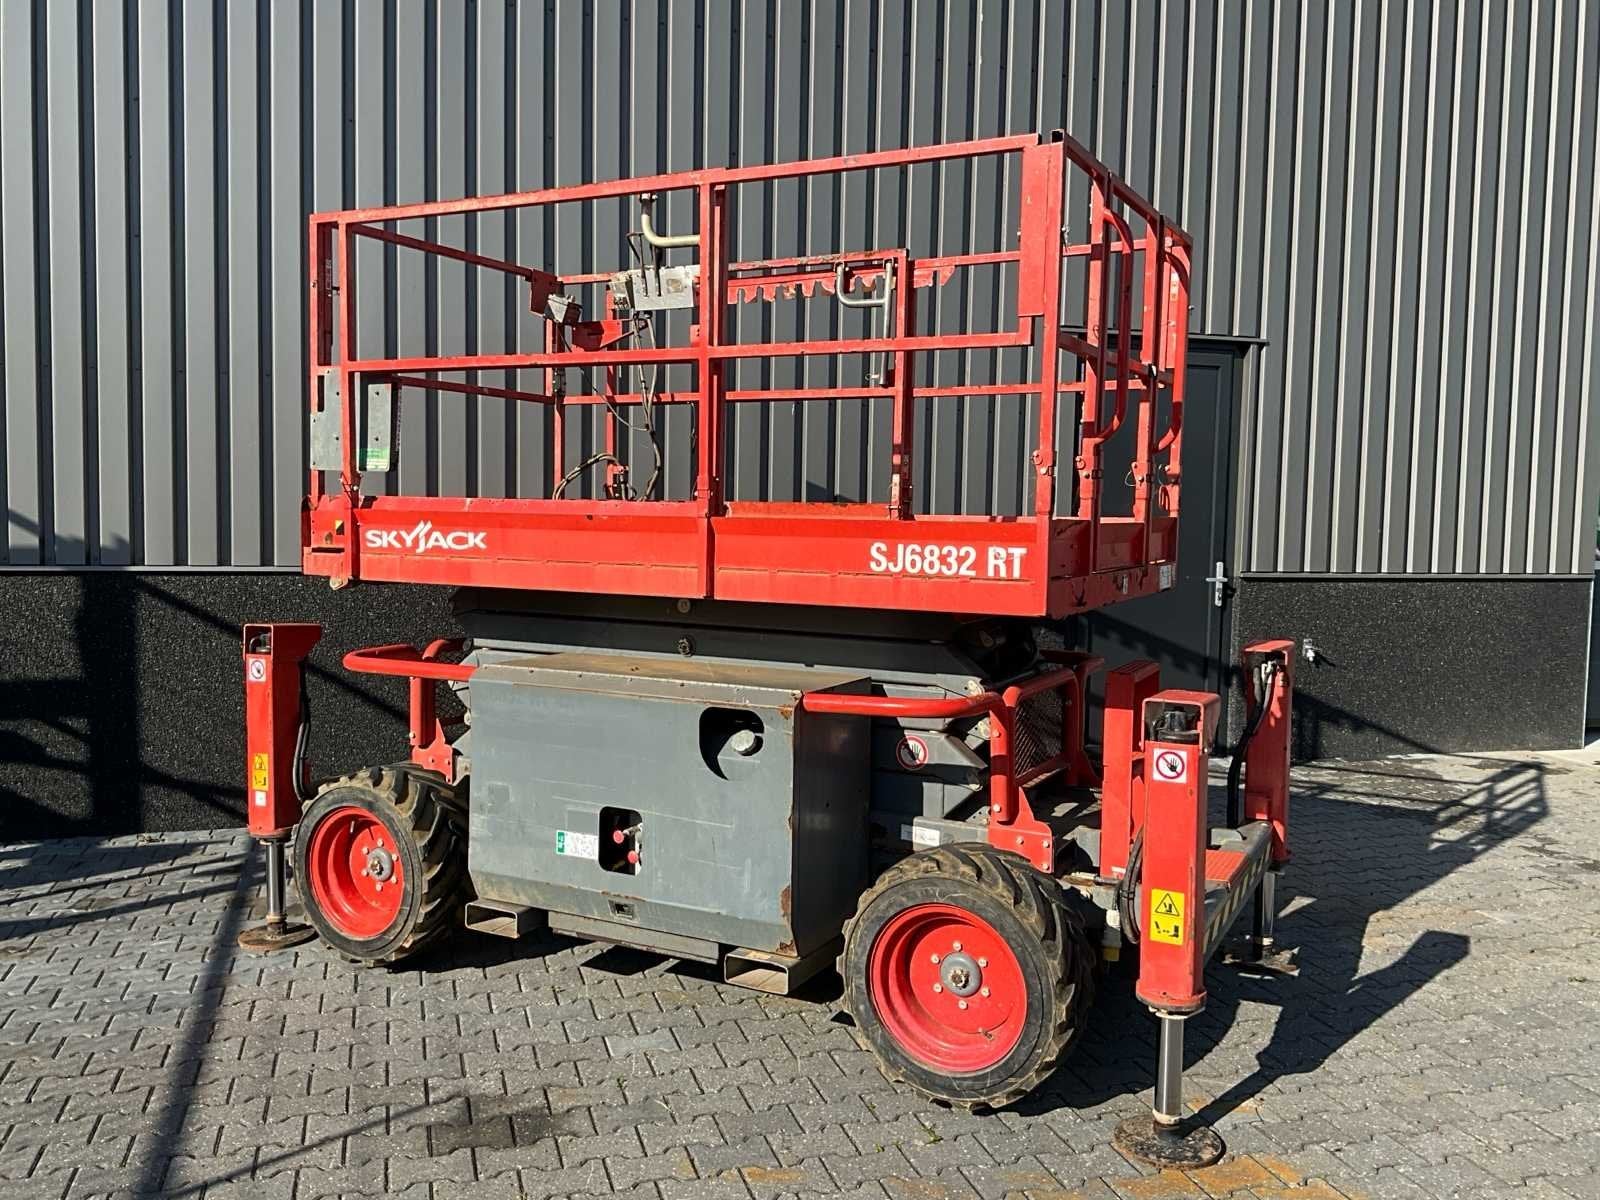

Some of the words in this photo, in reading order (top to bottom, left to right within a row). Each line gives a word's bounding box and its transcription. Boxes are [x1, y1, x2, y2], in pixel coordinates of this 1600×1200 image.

[365, 520, 487, 553] SKYJACK
[870, 542, 976, 576] SJ6832
[987, 546, 1027, 578] RT
